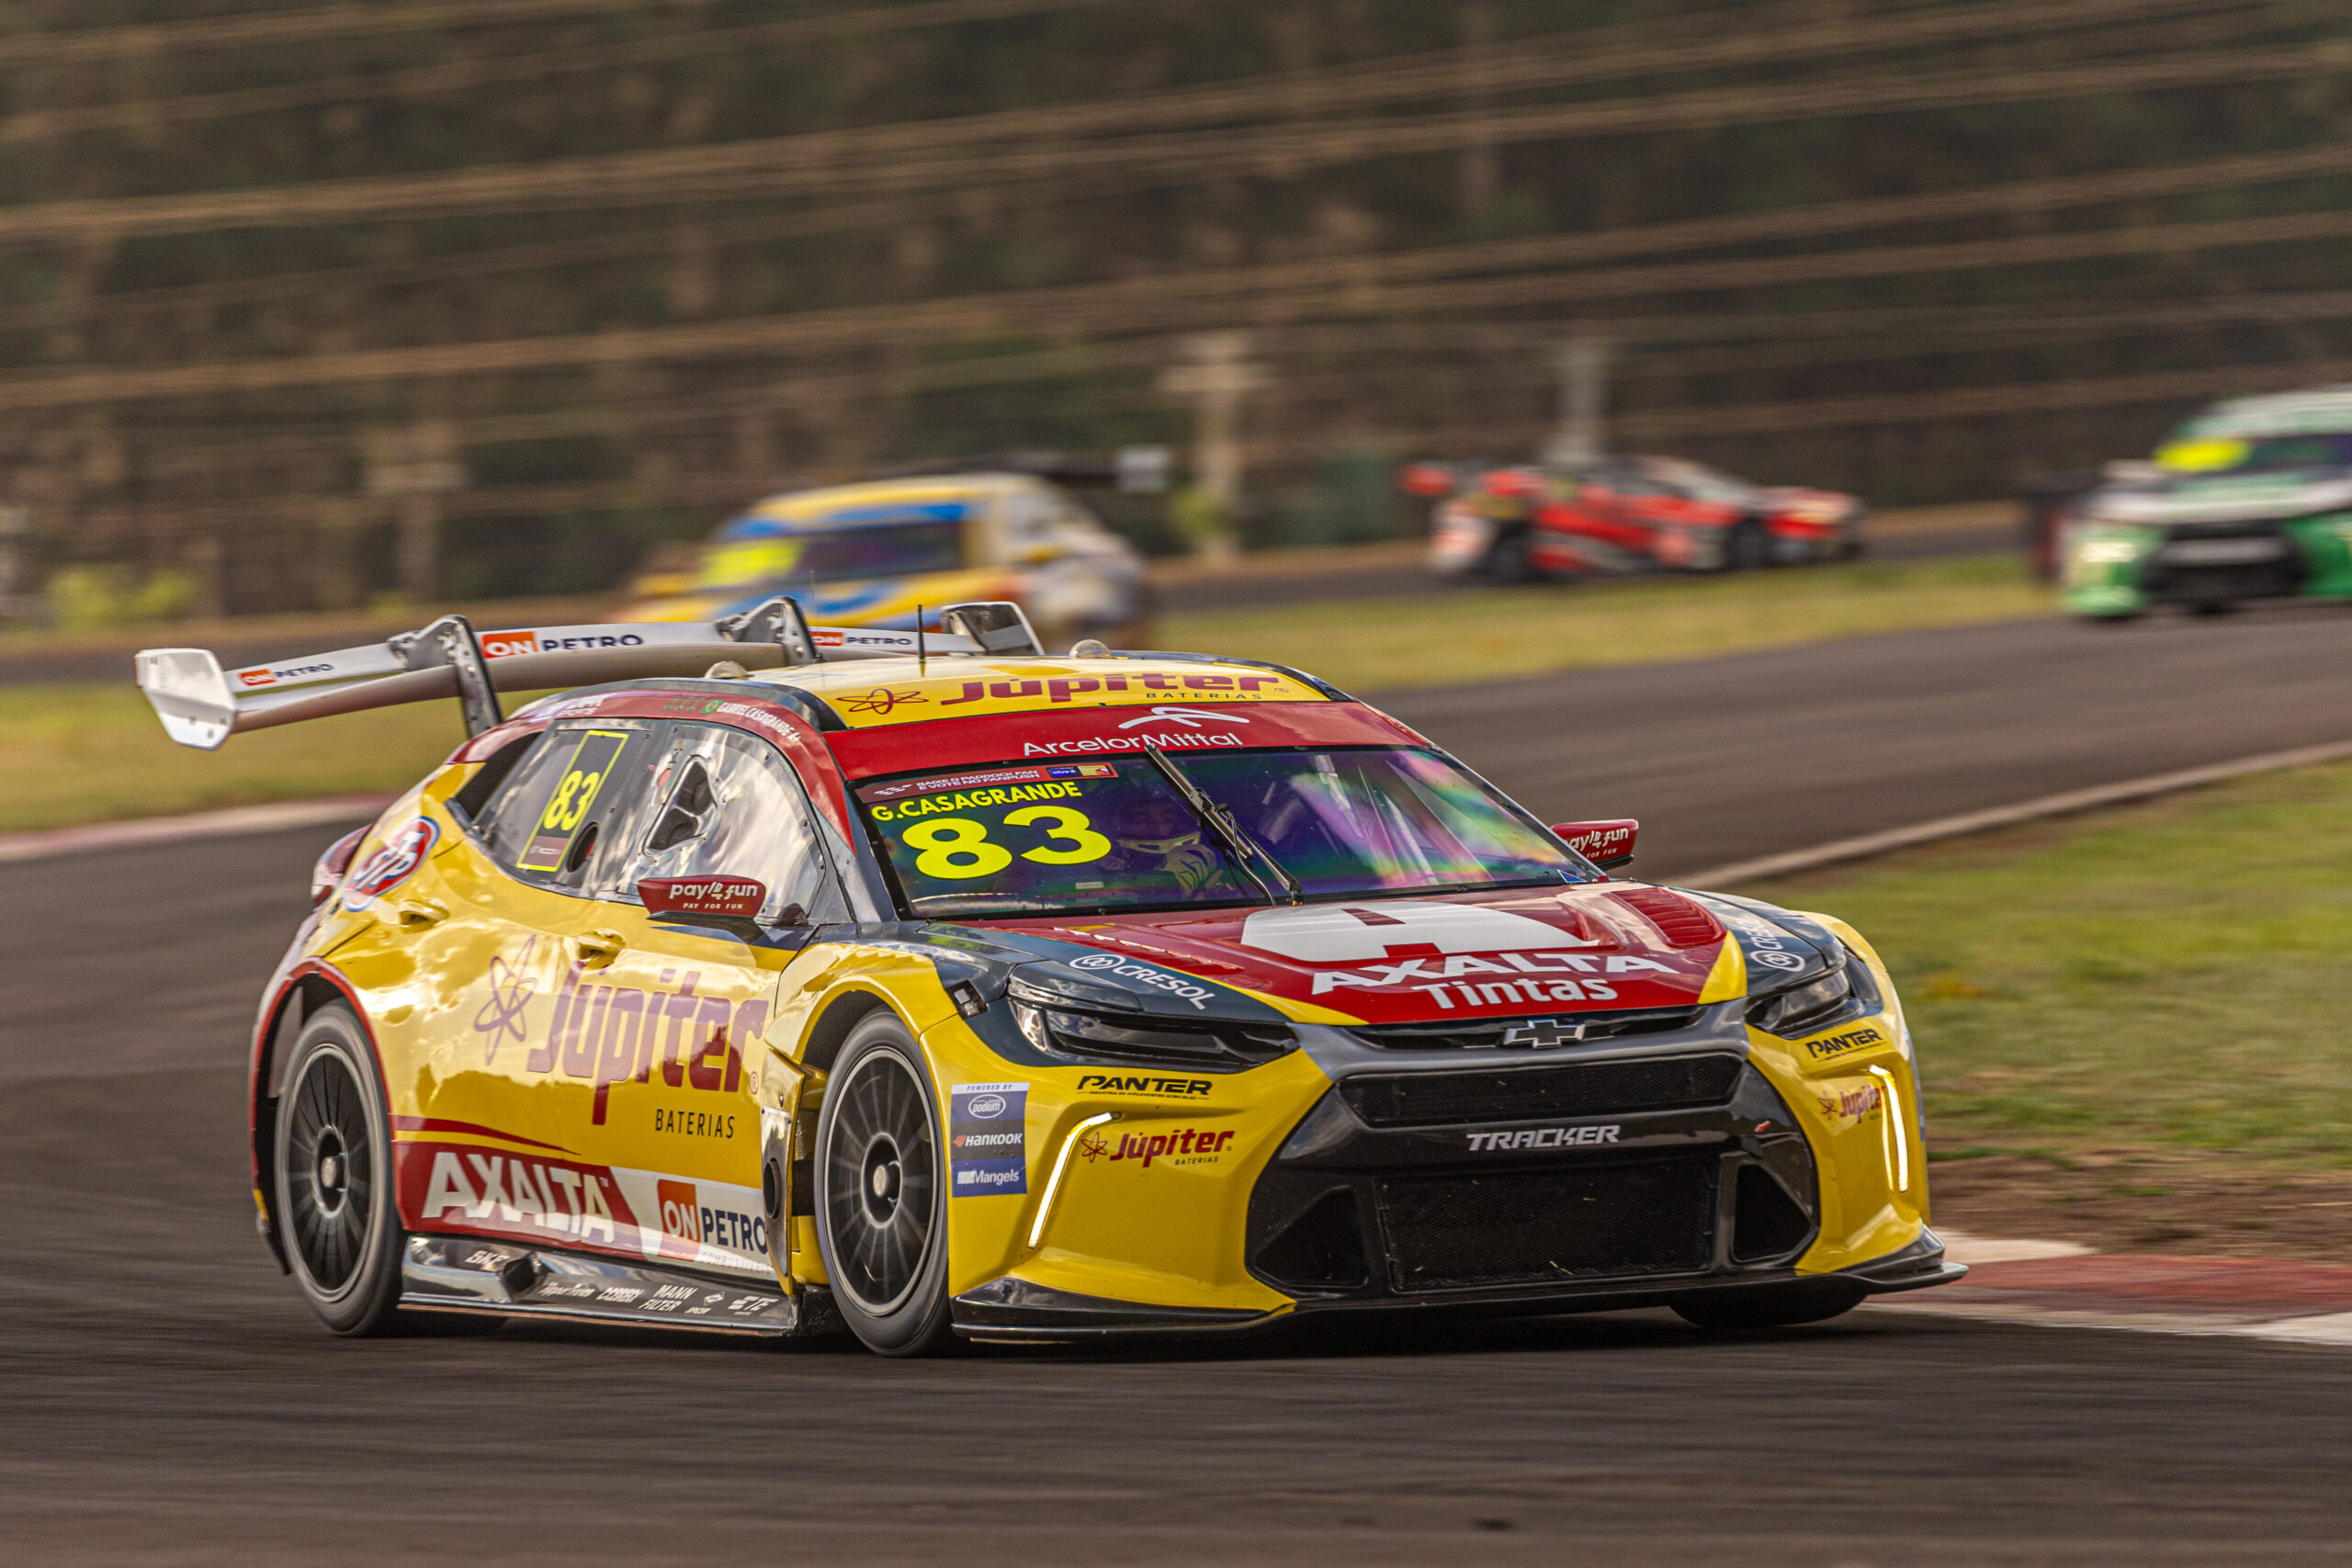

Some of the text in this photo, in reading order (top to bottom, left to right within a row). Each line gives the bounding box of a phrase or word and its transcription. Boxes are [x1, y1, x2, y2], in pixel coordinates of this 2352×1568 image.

[485, 634, 644, 656] ON PETRO
[847, 637, 912, 645] PETRO
[243, 663, 334, 682] ON PETRO
[716, 701, 751, 717] GABRIEL
[745, 707, 795, 737] CASAGRANDE
[1023, 733, 1244, 756] ArcelorMittal
[917, 778, 949, 787] BAIXE
[960, 772, 1013, 782] PADDOCK
[932, 780, 963, 790] VOTE
[963, 777, 982, 785] NO
[983, 773, 1041, 783] FANPUSH
[544, 770, 600, 831] 83
[871, 782, 1082, 821] G.CASAGRANDE
[902, 805, 1112, 879] 83
[1311, 953, 1679, 995] AXALTA
[1113, 965, 1216, 1010] CRESOL
[1412, 978, 1618, 1009] Tintas
[1806, 1029, 1883, 1058] PANTER
[1077, 1076, 1213, 1095] PANTER
[655, 1108, 734, 1139] BATERIAS
[1110, 1129, 1235, 1168] Júpiter
[1467, 1125, 1620, 1151] TRACKER
[1175, 1156, 1219, 1166] BATERIAS
[973, 1169, 1020, 1186] Mangels
[422, 1152, 615, 1244] AXALTA
[663, 1200, 768, 1255] ON PETRO
[464, 1250, 509, 1265] SKF
[653, 1284, 698, 1300] MANN
[639, 1299, 682, 1312] FILTER
